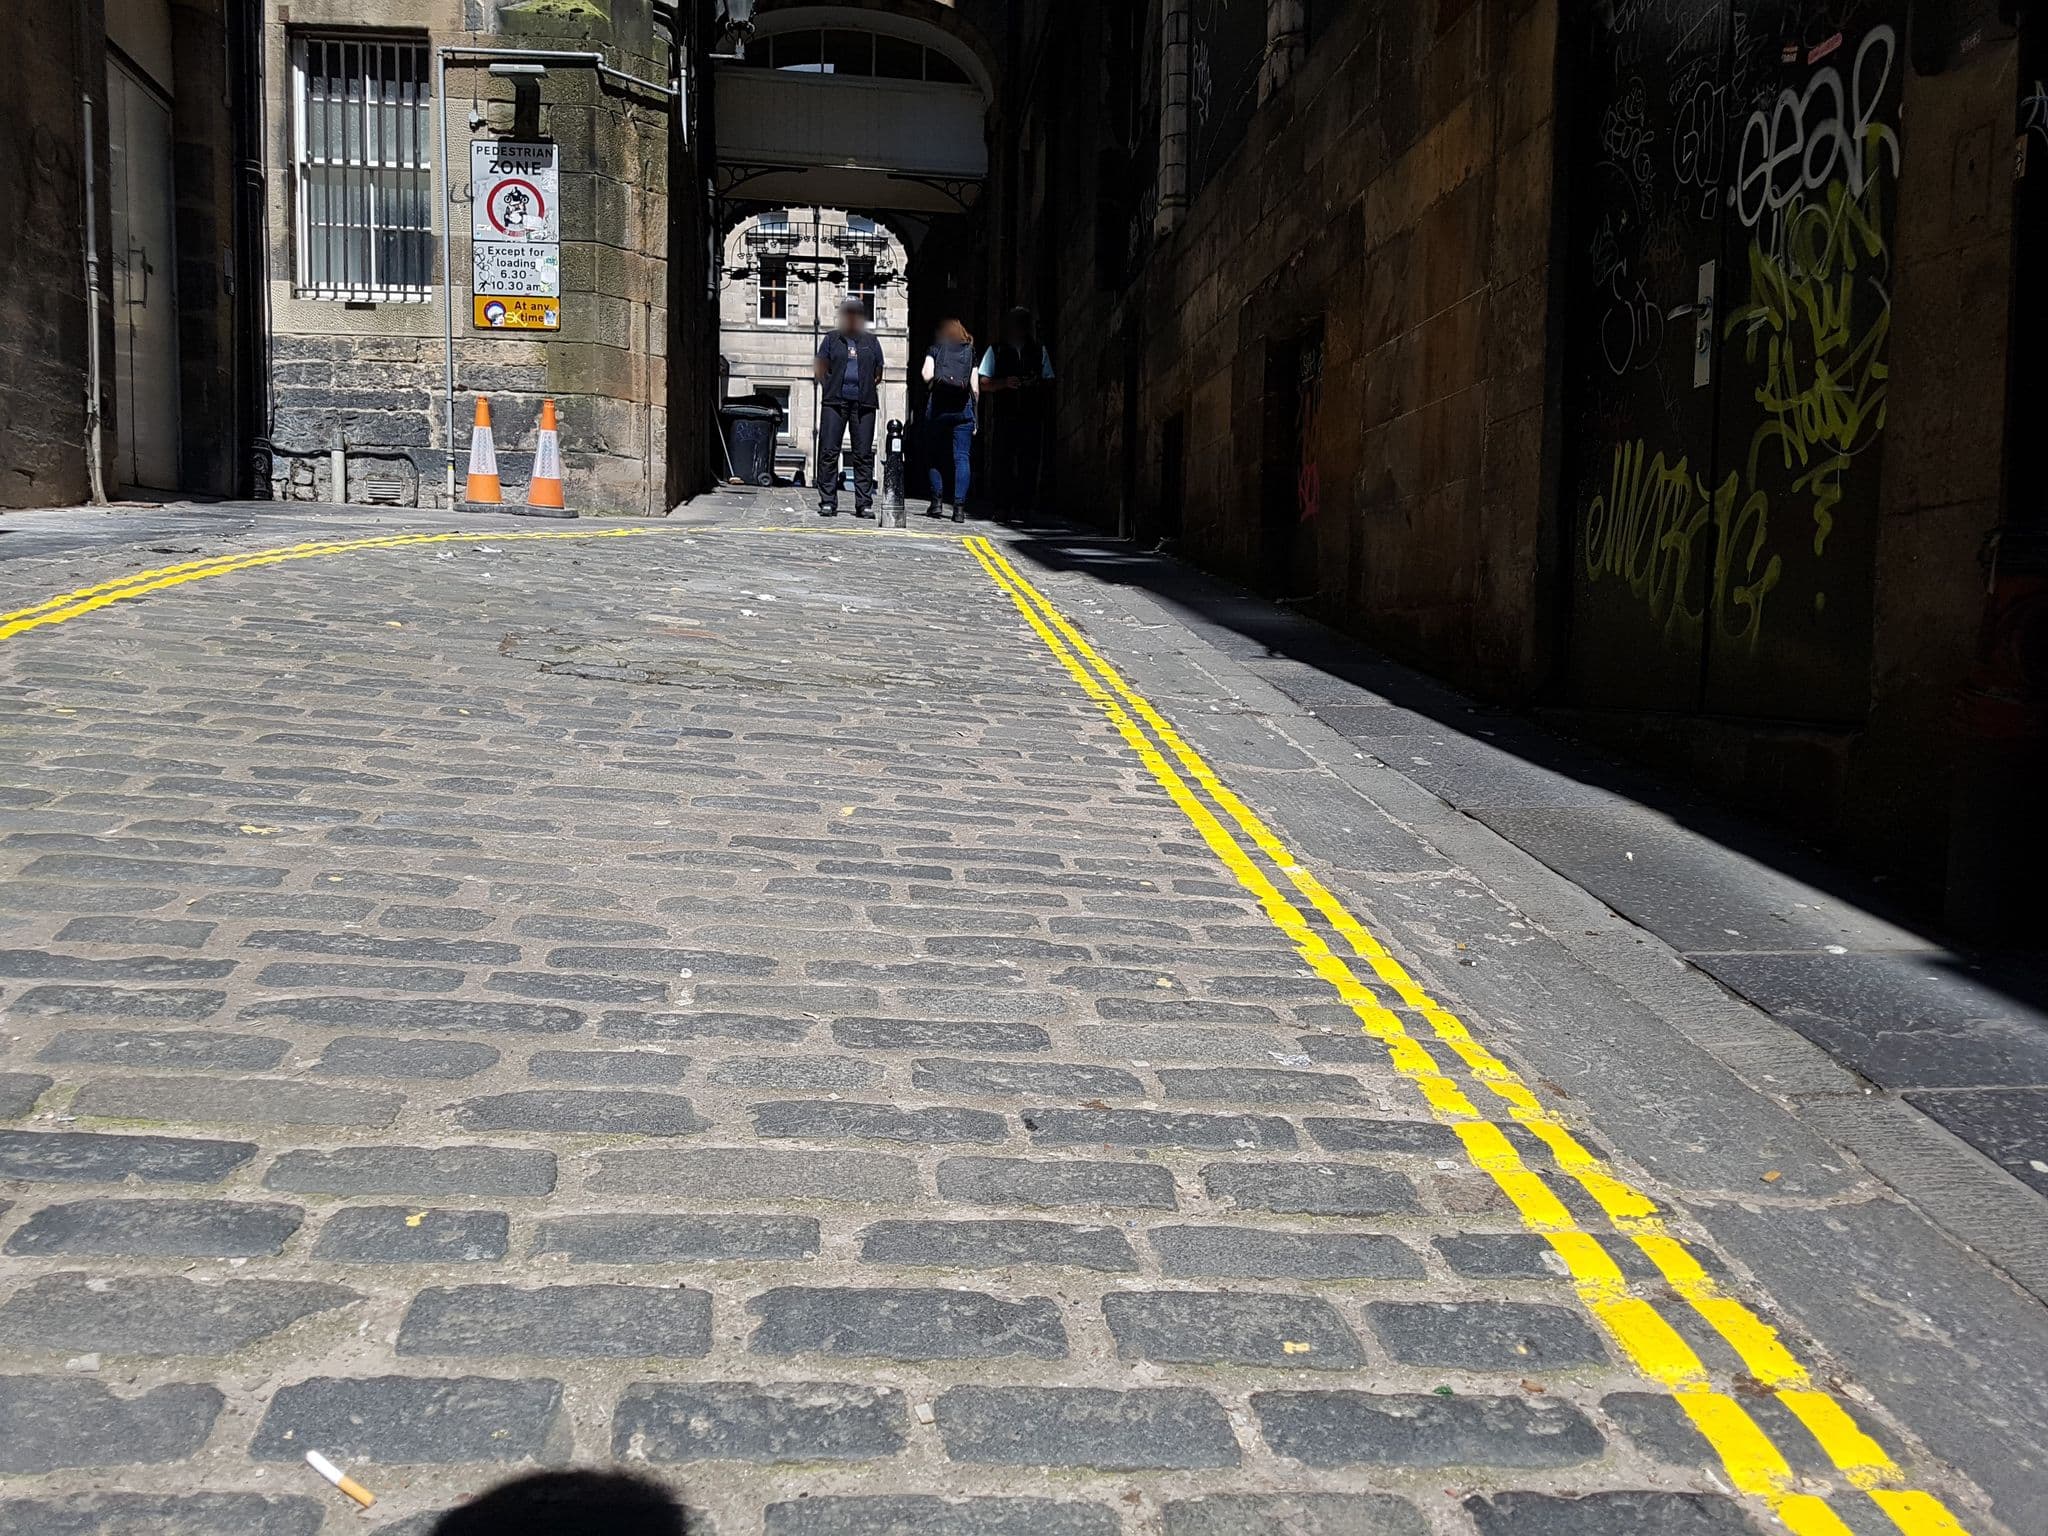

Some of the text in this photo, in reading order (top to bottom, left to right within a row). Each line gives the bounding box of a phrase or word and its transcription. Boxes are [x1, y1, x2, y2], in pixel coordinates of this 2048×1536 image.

[476, 145, 553, 158] PEDESTRIAN
[489, 160, 542, 175] ZONE
[487, 246, 545, 257] Except for
[496, 258, 536, 269] loading
[500, 269, 527, 279] 6.30
[492, 280, 524, 290] 10.30
[514, 301, 550, 311] At any
[520, 312, 544, 322] time
